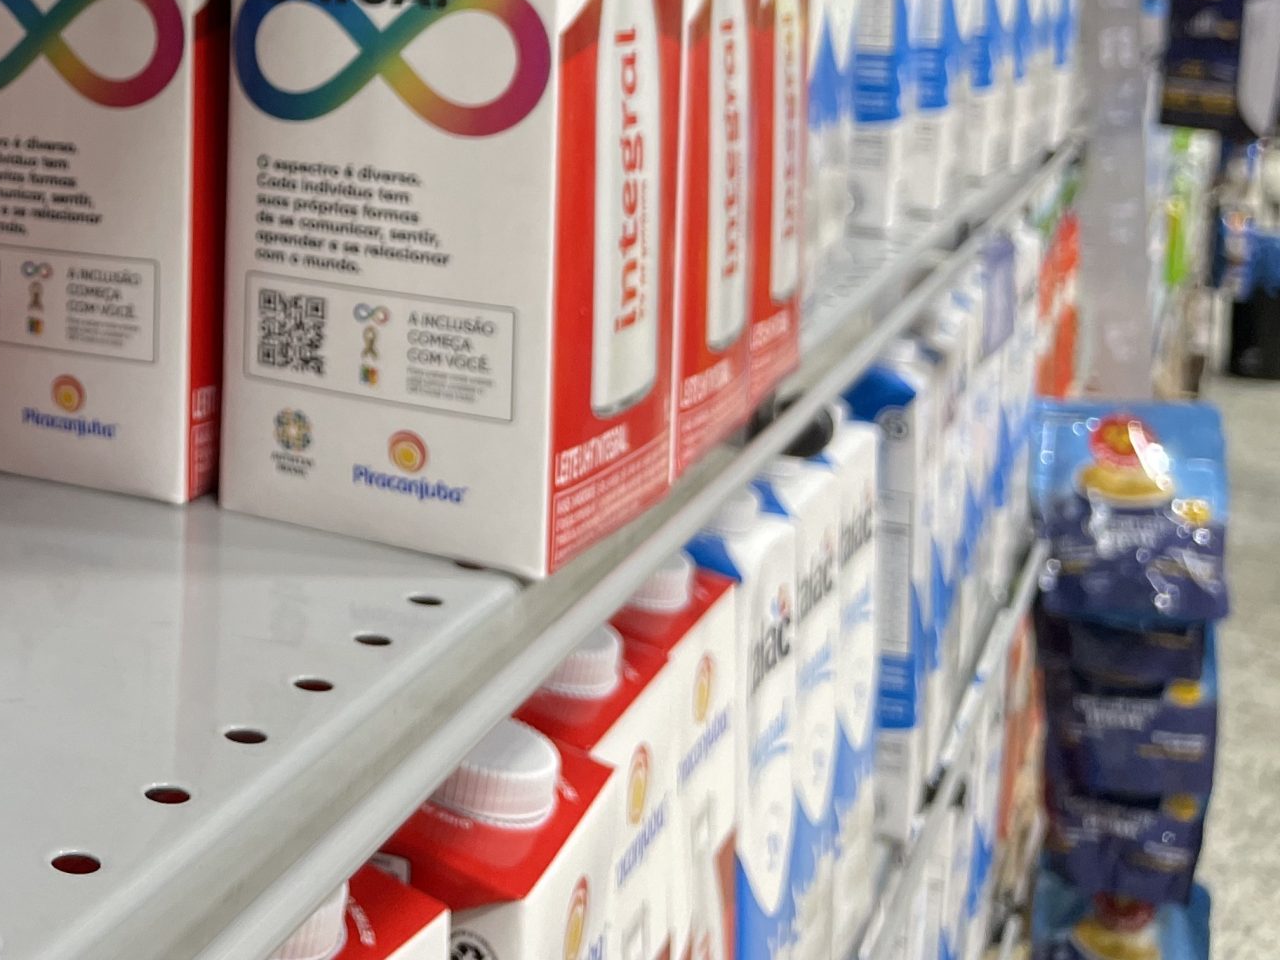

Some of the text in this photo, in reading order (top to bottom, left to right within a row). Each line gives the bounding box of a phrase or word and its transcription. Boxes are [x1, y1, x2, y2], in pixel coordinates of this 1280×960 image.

[613, 23, 644, 334] integral
[421, 312, 496, 338] INCLUSÃO
[406, 328, 472, 353] COMEÇA
[406, 347, 442, 365] COM
[352, 462, 464, 504] Piracanjuba
